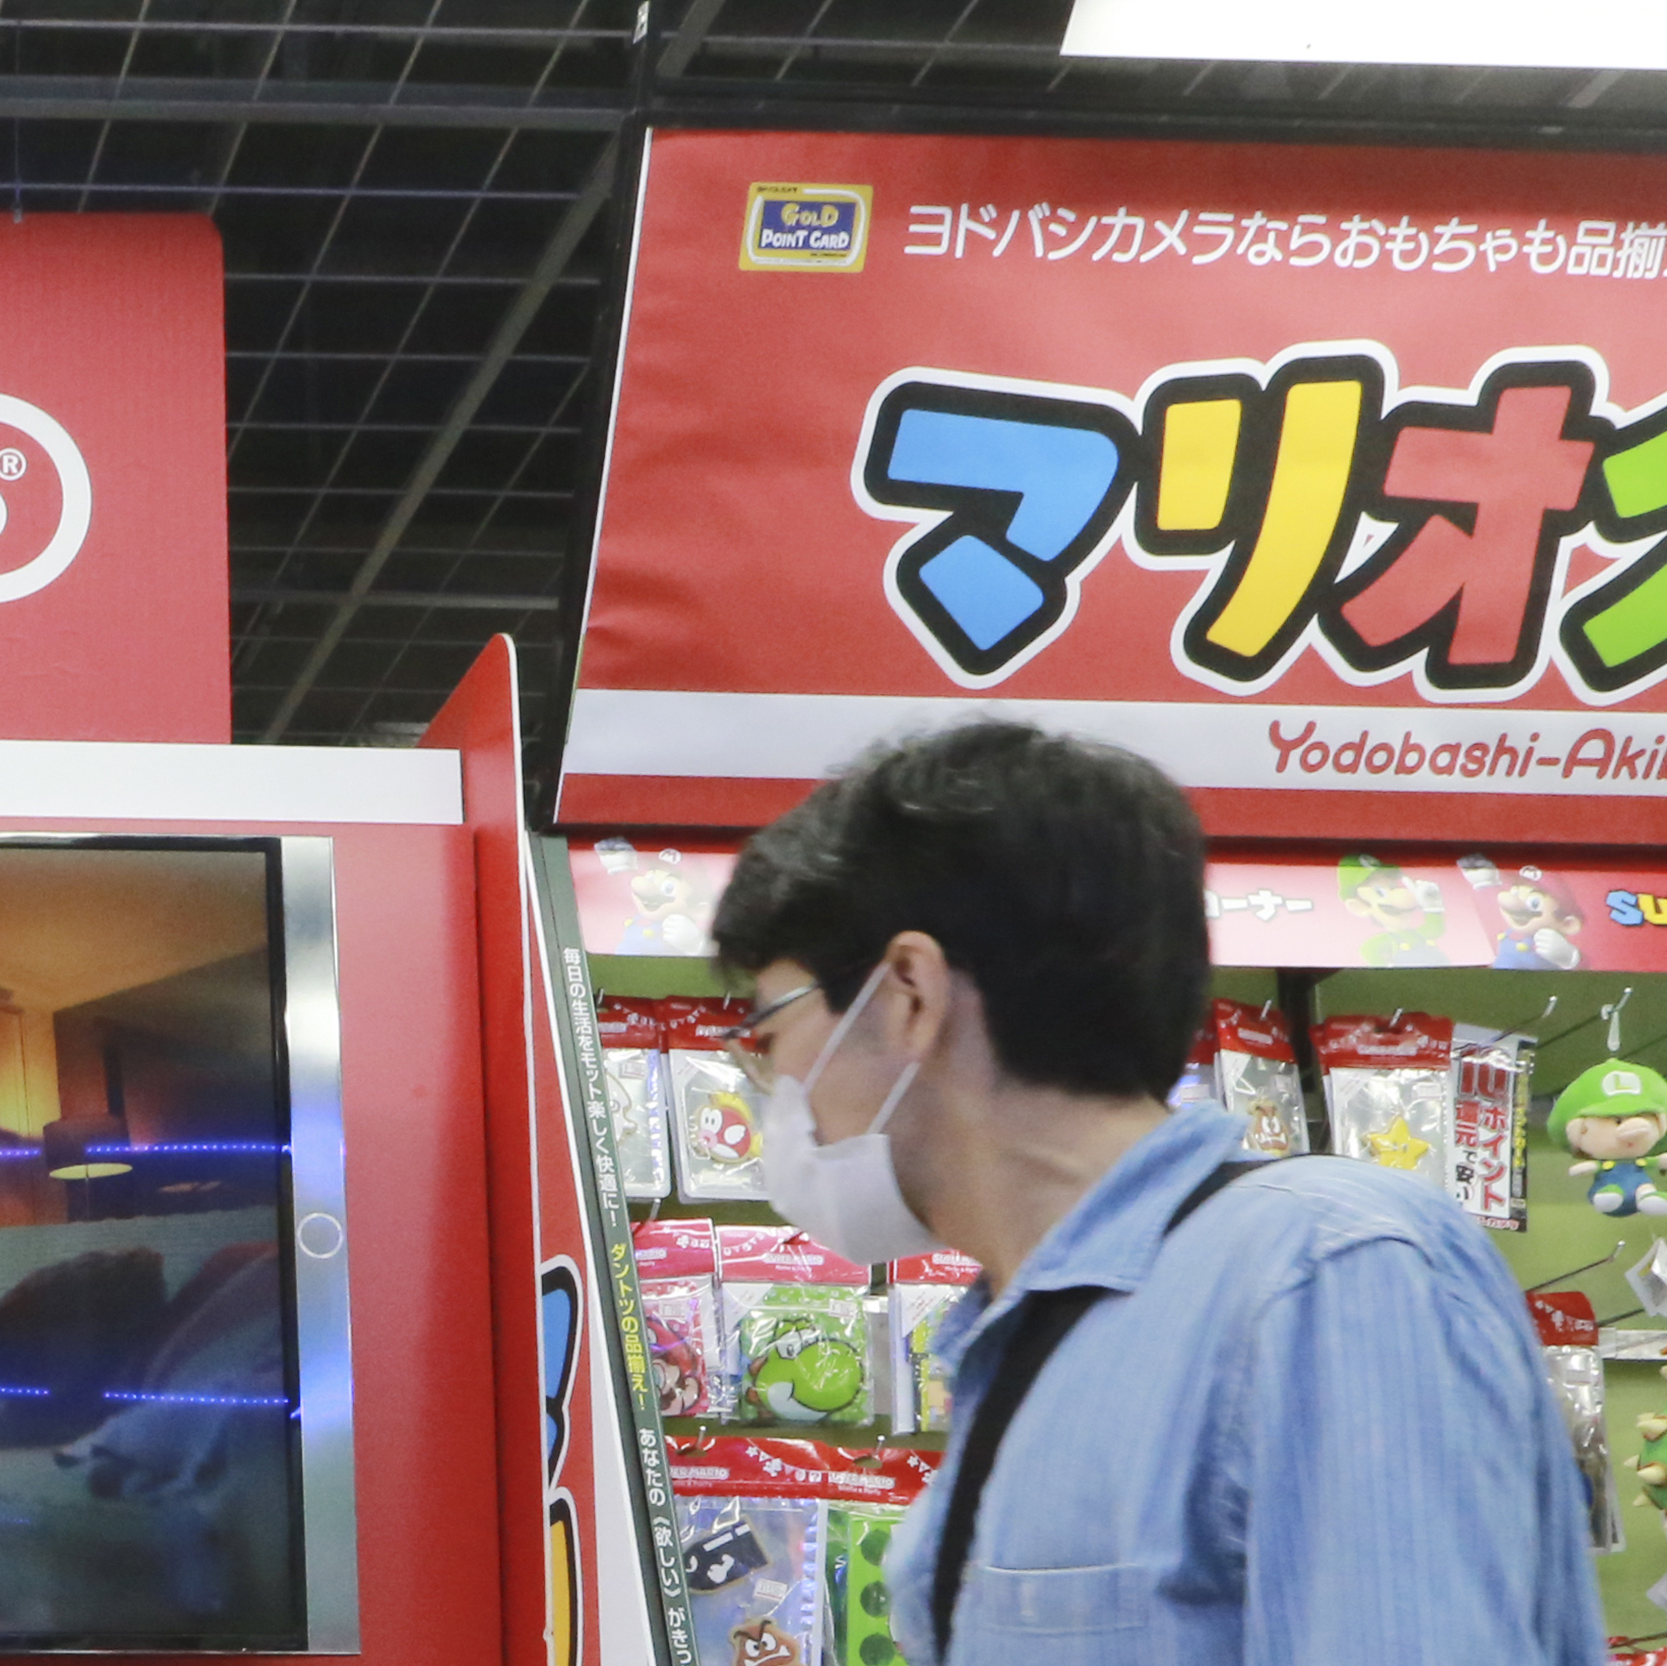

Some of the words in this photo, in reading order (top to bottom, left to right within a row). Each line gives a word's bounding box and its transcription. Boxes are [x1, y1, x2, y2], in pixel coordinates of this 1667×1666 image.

[760, 228, 809, 249] POINT
[809, 230, 850, 250] CARD
[903, 201, 1667, 281] ヨドバシカメラならおもちゃも品揃
[1269, 719, 1667, 781] Yodobashi-Aki
